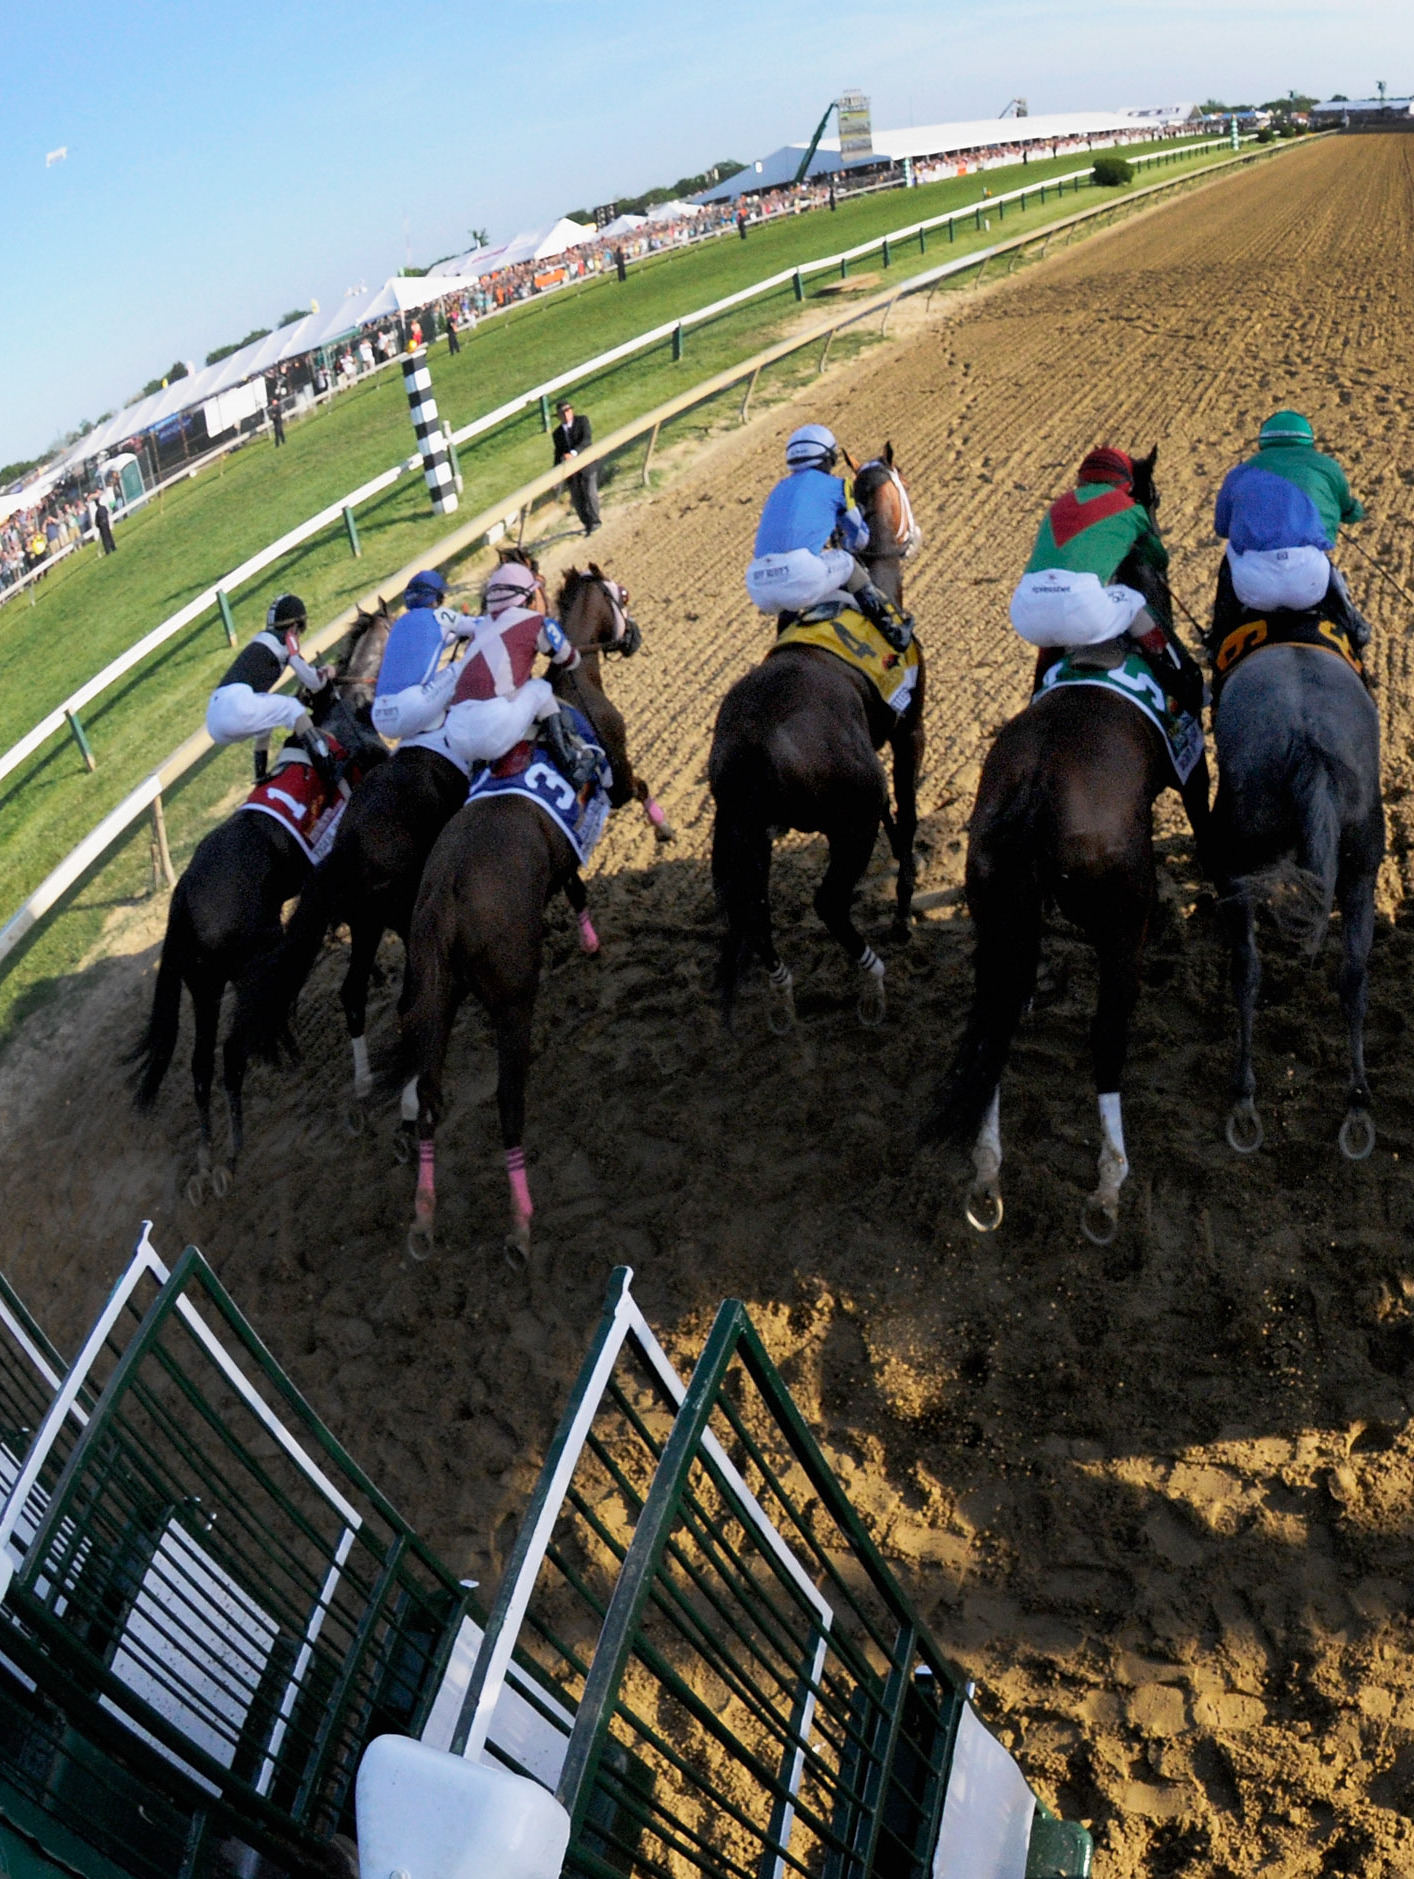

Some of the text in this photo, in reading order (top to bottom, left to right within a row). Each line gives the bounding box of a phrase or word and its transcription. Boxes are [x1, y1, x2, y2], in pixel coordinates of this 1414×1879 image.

[441, 610, 458, 625] 2
[547, 622, 563, 644] 3
[830, 621, 878, 659] 4
[1216, 619, 1268, 672] 6
[1107, 660, 1166, 713] 5
[266, 786, 308, 821] 1
[524, 762, 576, 810] 3
